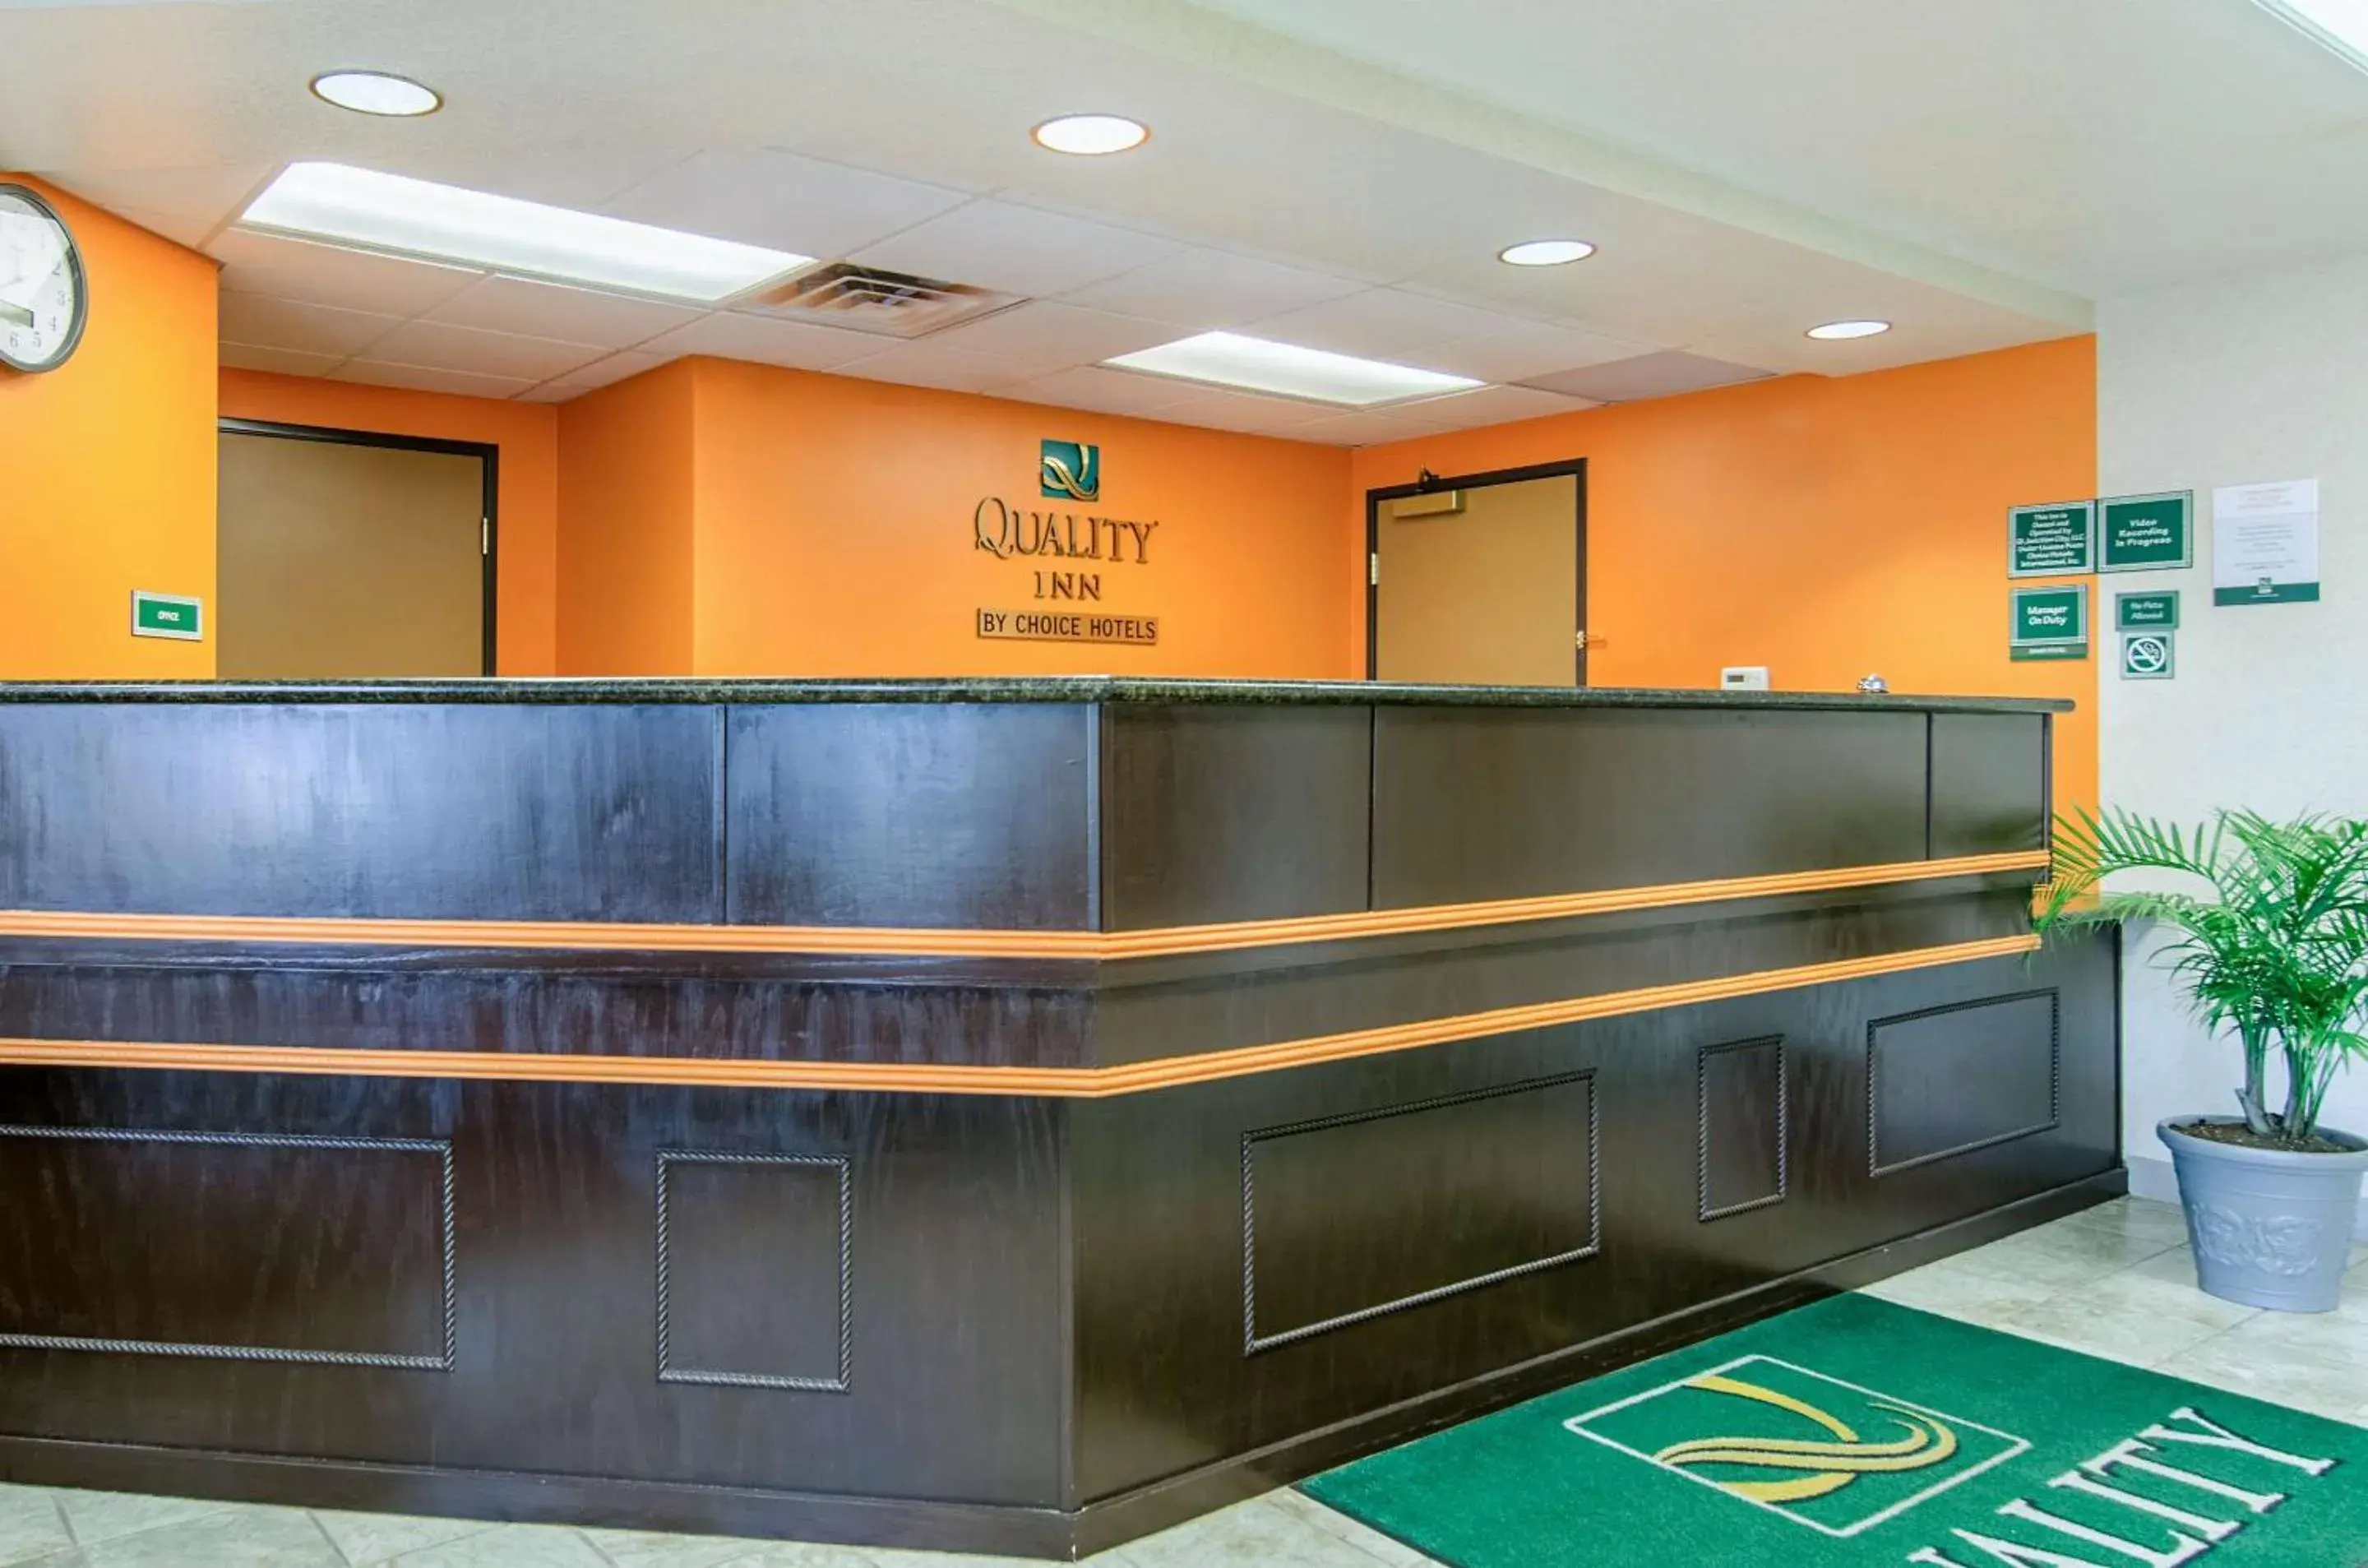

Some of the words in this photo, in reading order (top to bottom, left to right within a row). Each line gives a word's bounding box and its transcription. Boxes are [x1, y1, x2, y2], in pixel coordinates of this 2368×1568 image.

[48, 315, 57, 332] 4
[2129, 519, 2158, 528] Video
[975, 497, 1158, 564] QUALITY
[2119, 528, 2169, 538] Recording
[2127, 537, 2172, 547] Progress
[1034, 571, 1100, 601] INN
[2027, 606, 2070, 616] Manager
[983, 613, 1007, 632] BY
[1015, 615, 1081, 636] CHOICE
[1089, 617, 1156, 639] HOTELS
[2028, 616, 2042, 626] On
[2042, 615, 2069, 627] Duty
